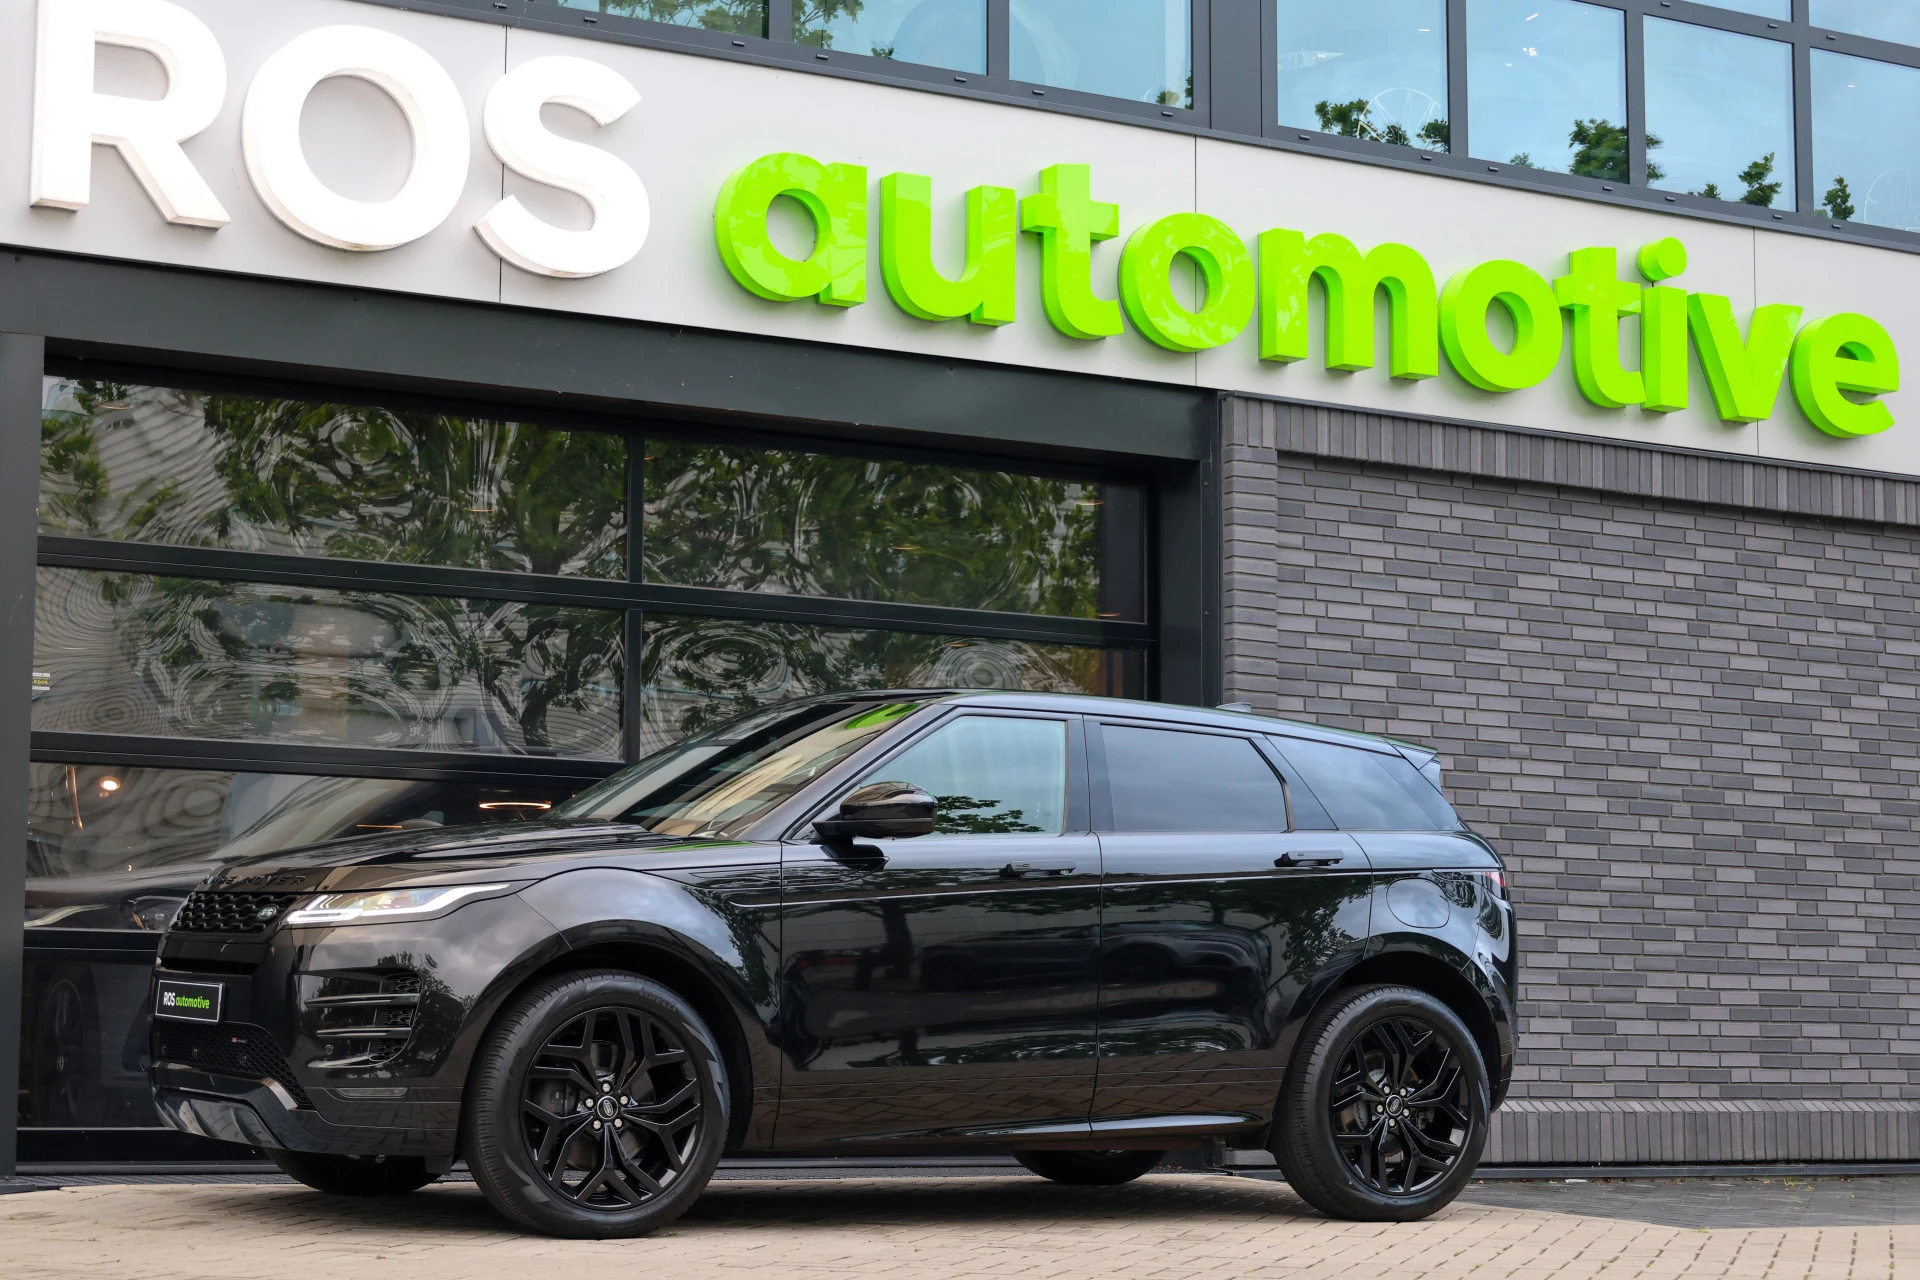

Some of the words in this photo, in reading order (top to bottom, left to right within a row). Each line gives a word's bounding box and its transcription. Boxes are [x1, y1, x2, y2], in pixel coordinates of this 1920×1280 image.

[30, 0, 651, 278] ROS
[714, 152, 1899, 438] automotive
[163, 991, 175, 1006] ROS
[175, 995, 210, 1009] automotive
